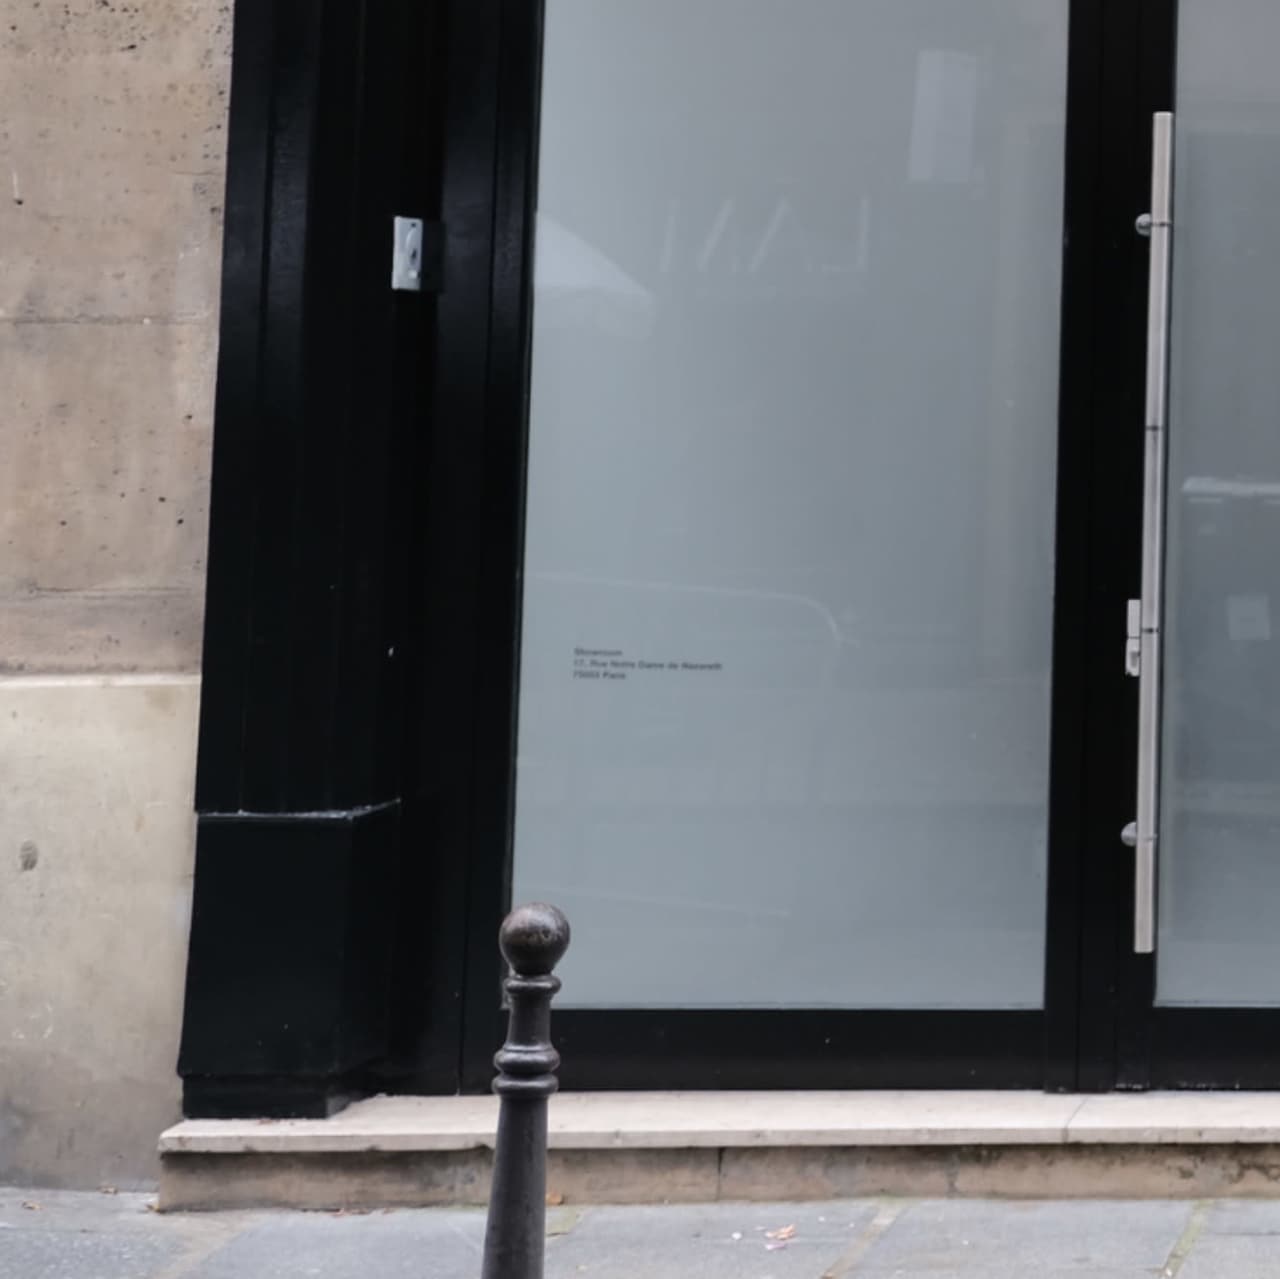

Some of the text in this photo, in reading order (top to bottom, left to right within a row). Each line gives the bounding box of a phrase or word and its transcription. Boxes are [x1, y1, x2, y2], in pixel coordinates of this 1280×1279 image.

[590, 659, 608, 668] Rue
[637, 659, 665, 670] Dame
[667, 660, 679, 670] de
